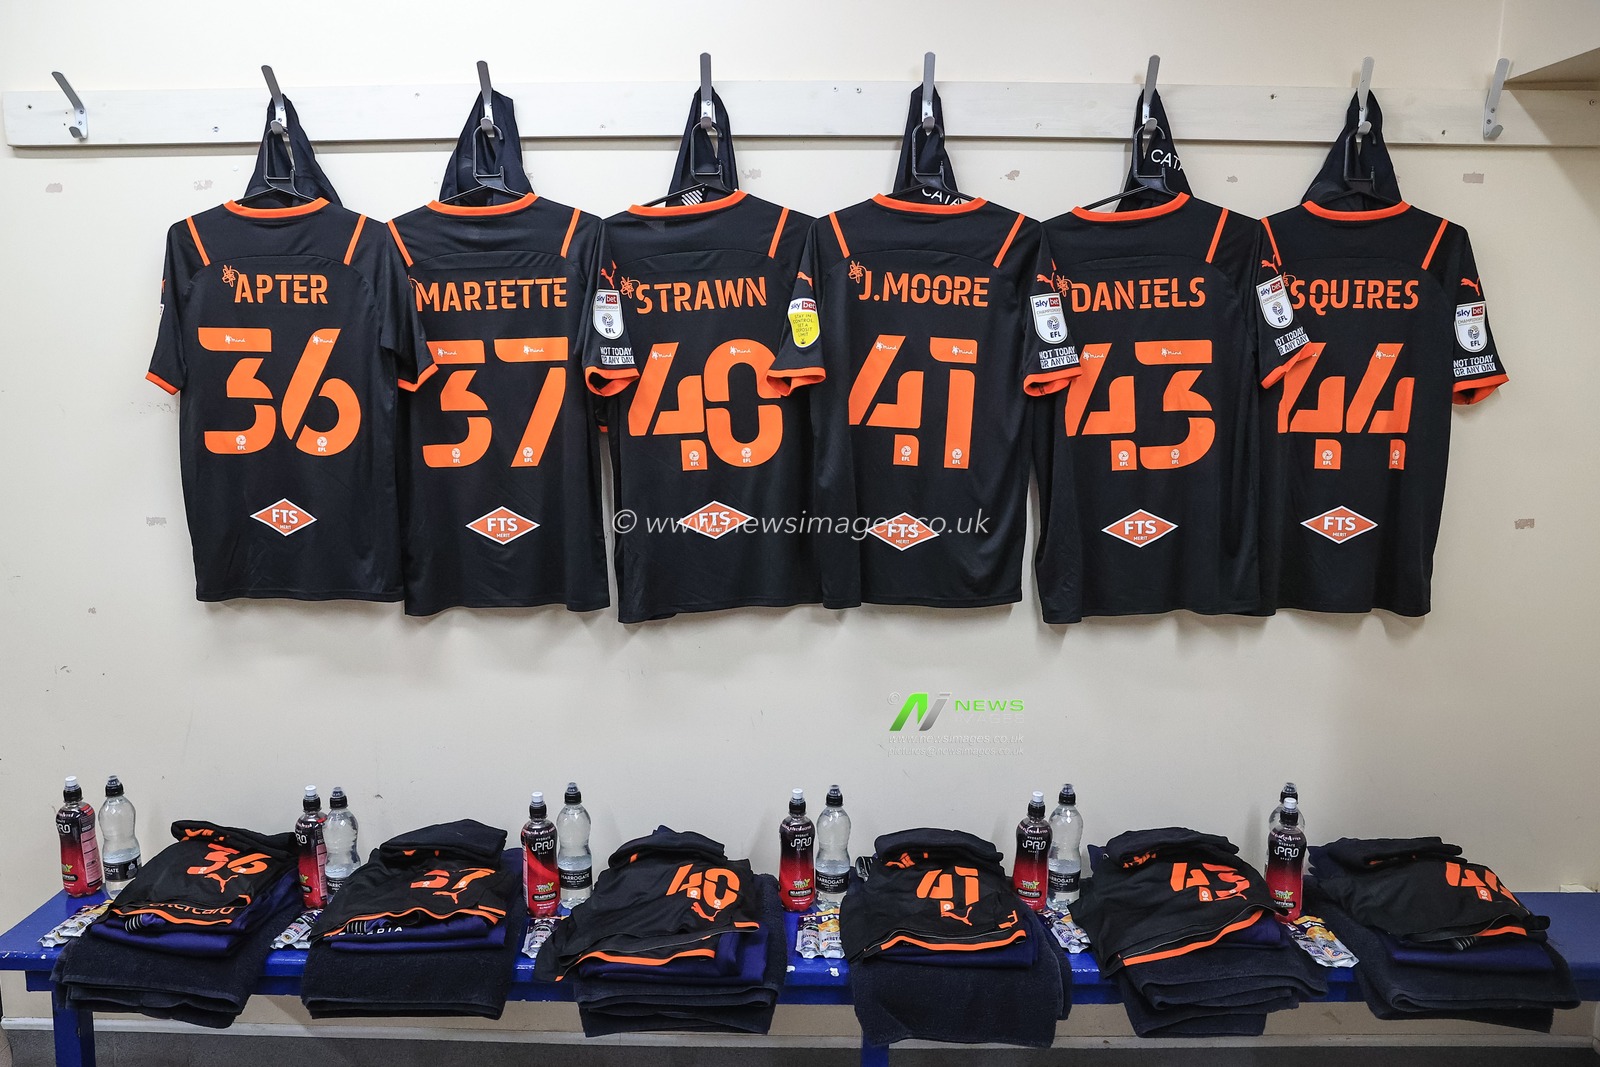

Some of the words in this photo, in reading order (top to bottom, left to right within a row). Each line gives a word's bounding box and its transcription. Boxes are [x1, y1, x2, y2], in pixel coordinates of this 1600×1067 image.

[234, 274, 328, 304] APTER
[415, 277, 567, 311] MARIETTE
[635, 276, 767, 315] STRAWN
[858, 270, 990, 307] J.MOORE
[1071, 277, 1206, 313] DANIELS
[1290, 279, 1419, 316] SQUIRES
[1277, 315, 1288, 323] EFL
[1285, 327, 1304, 341] TODAY
[611, 347, 632, 355] TODAY
[1055, 346, 1076, 356] TODAY
[1285, 340, 1297, 352] ANY
[1296, 334, 1309, 346] DAY
[608, 356, 620, 364] ANY
[1050, 358, 1065, 367] ANY
[1066, 355, 1078, 364] DAY
[1453, 359, 1469, 368] NOT
[1470, 355, 1494, 365] TODAY
[1466, 365, 1481, 374] ANY
[1481, 362, 1495, 372] DAY
[198, 327, 361, 456] 36
[422, 336, 568, 468] 37
[628, 338, 783, 471] 40
[848, 334, 978, 470] 41
[1065, 339, 1216, 471] 43
[1278, 342, 1415, 470] 44
[271, 509, 299, 524] FTS
[487, 517, 519, 532] FTS
[698, 511, 731, 527] FTS
[887, 523, 919, 539] FTS
[1124, 519, 1157, 535] FTS
[1323, 516, 1357, 531] FTS
[187, 843, 272, 875] 36
[666, 864, 740, 910] 40
[916, 866, 980, 914] 41
[1170, 862, 1250, 902] 43
